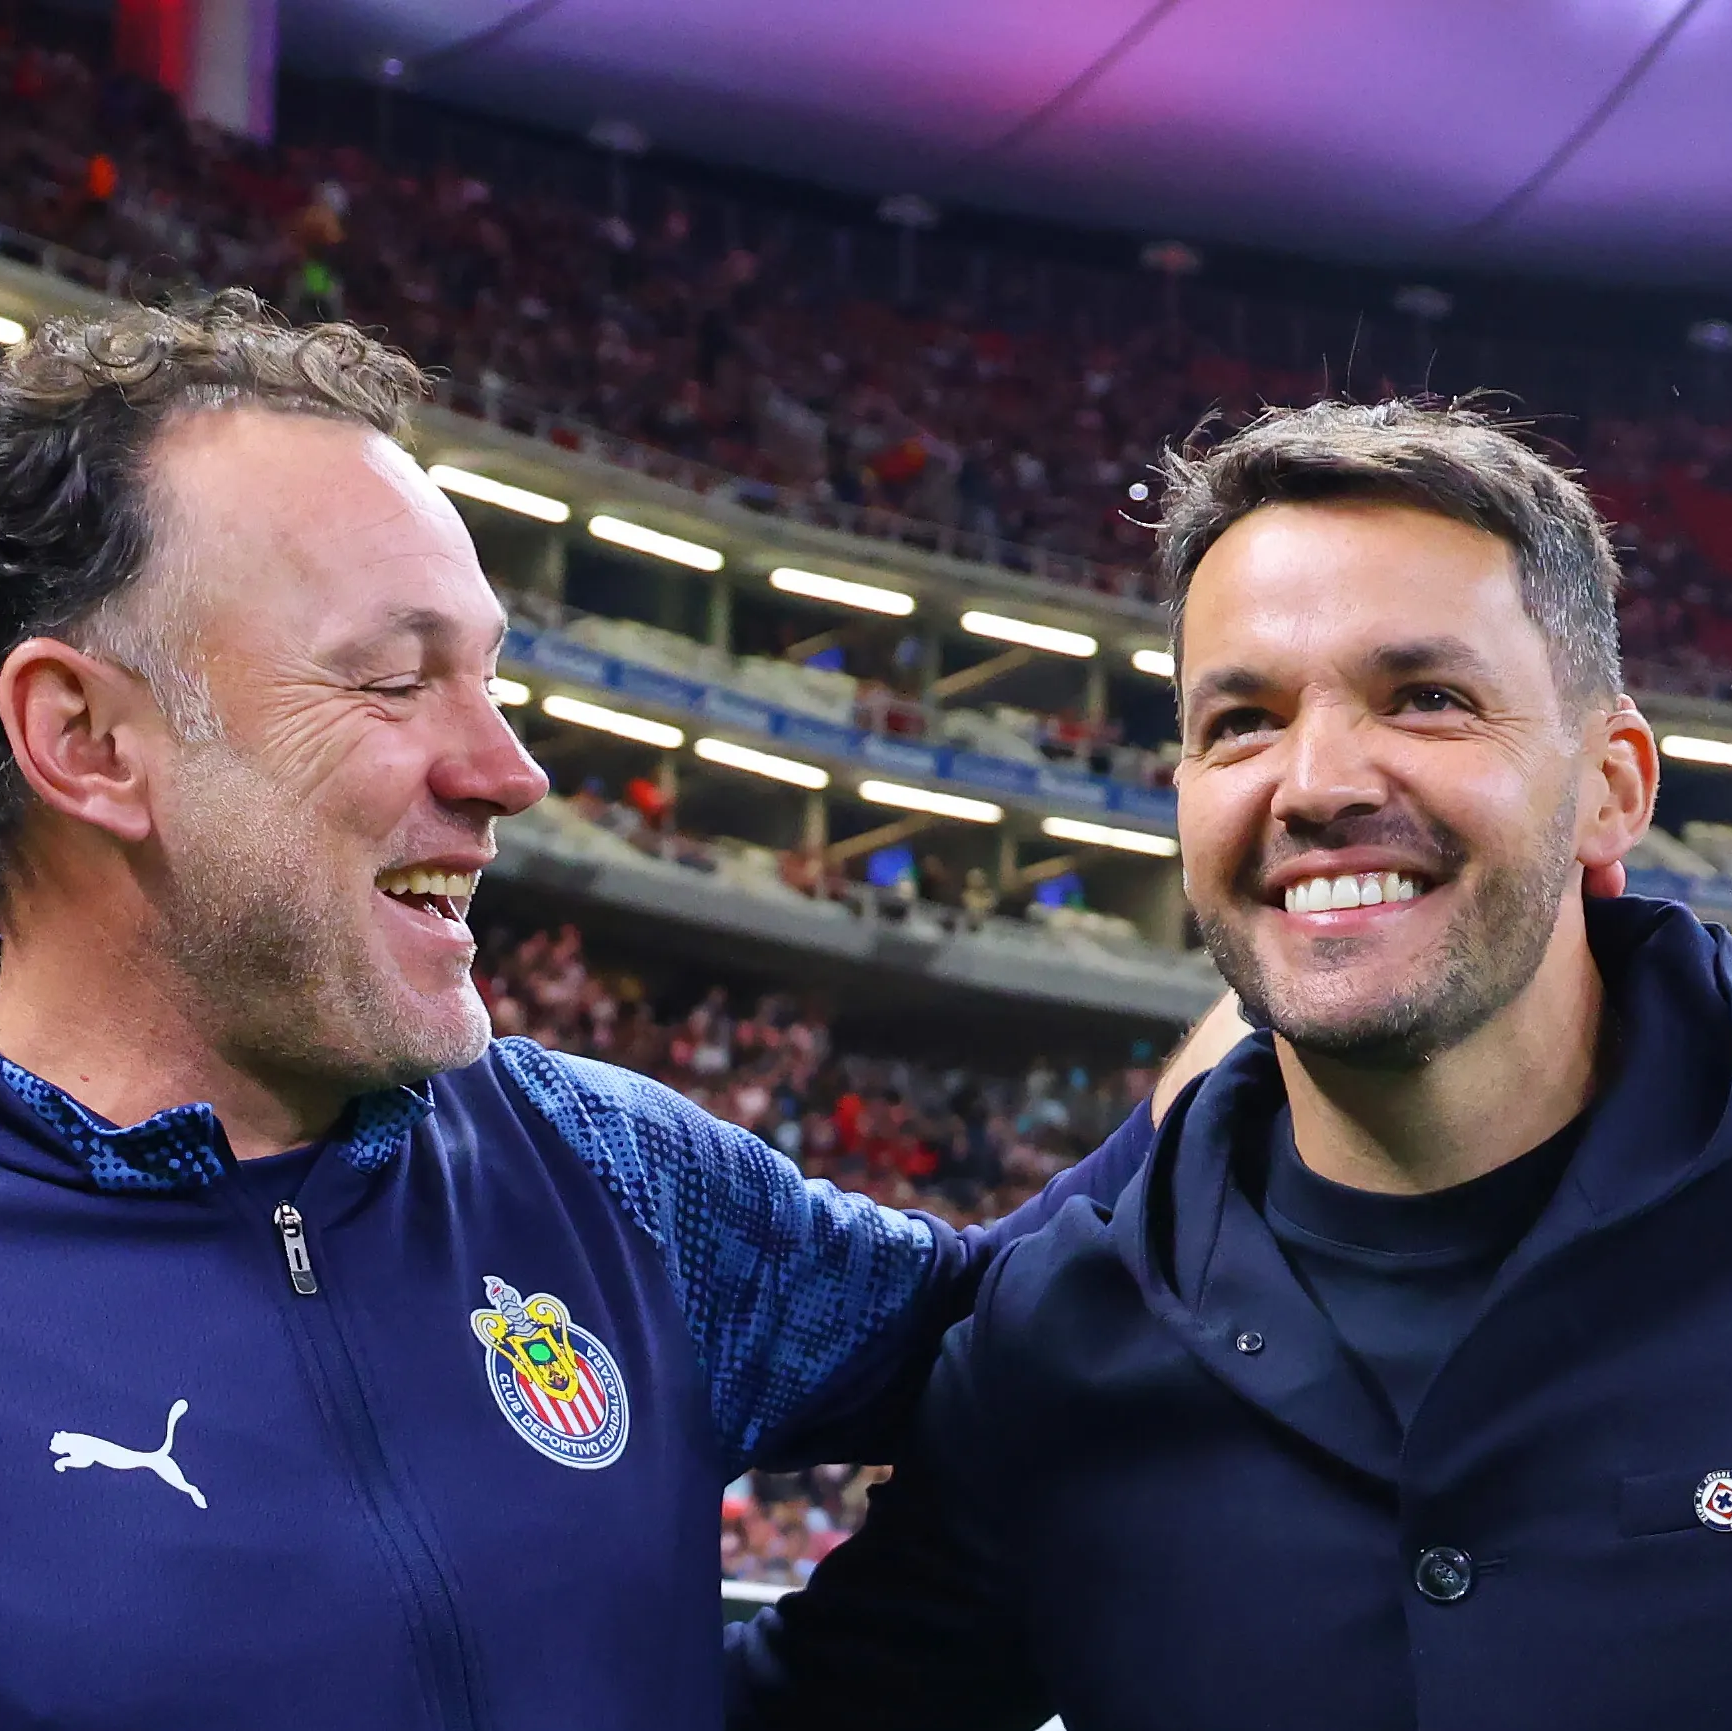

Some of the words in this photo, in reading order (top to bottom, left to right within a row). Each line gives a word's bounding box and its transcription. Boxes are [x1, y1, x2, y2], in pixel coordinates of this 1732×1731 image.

[499, 1373, 523, 1413] CLUB
[521, 1414, 600, 1455] DEPORTIVO
[586, 1345, 620, 1448] GUADALAJARA
